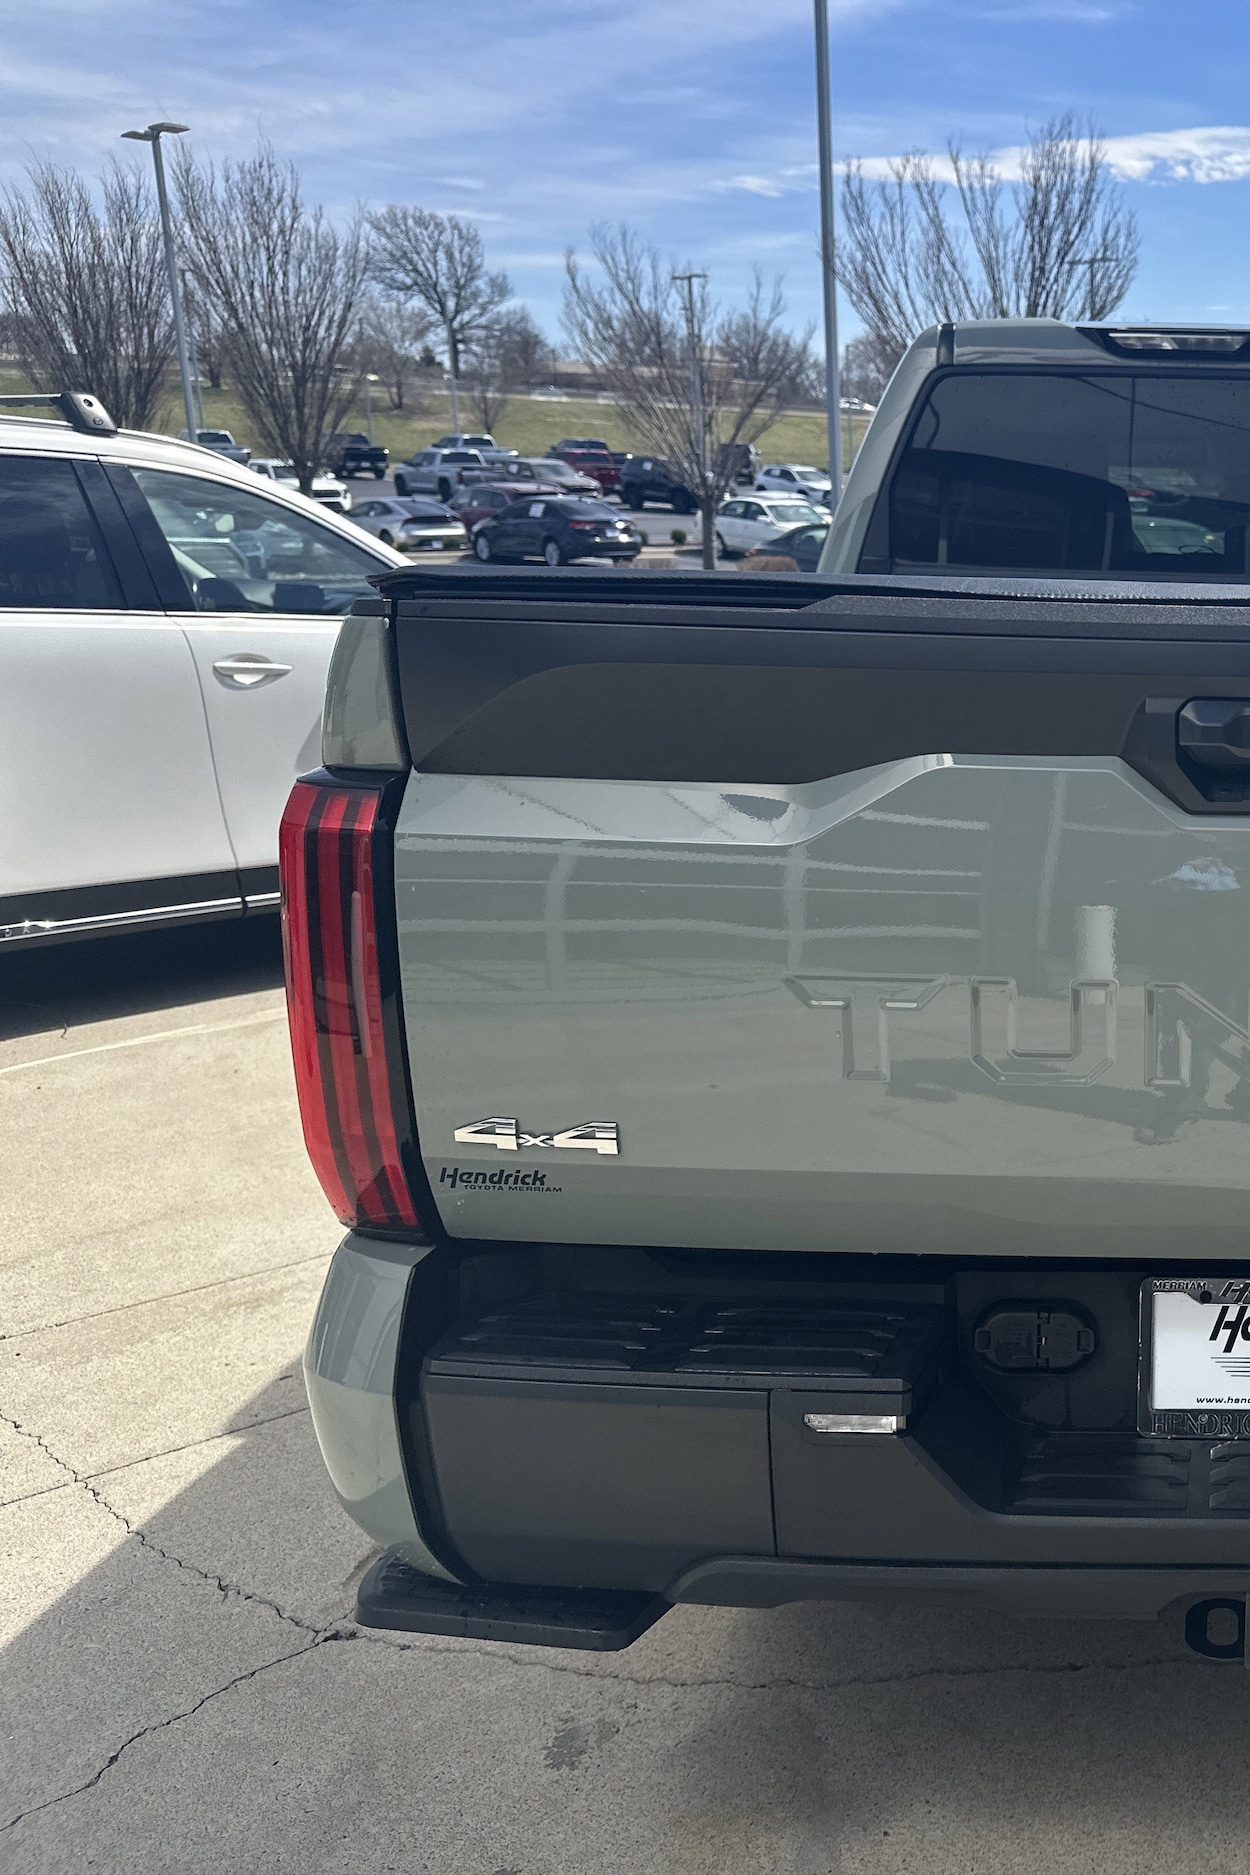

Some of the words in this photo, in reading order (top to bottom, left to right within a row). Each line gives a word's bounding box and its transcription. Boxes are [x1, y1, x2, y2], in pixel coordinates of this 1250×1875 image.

[439, 1166, 548, 1189] Hendrick
[463, 1184, 504, 1192] TOYOTA
[508, 1186, 563, 1194] MERRIAM
[1152, 1280, 1207, 1290] MERRIAM
